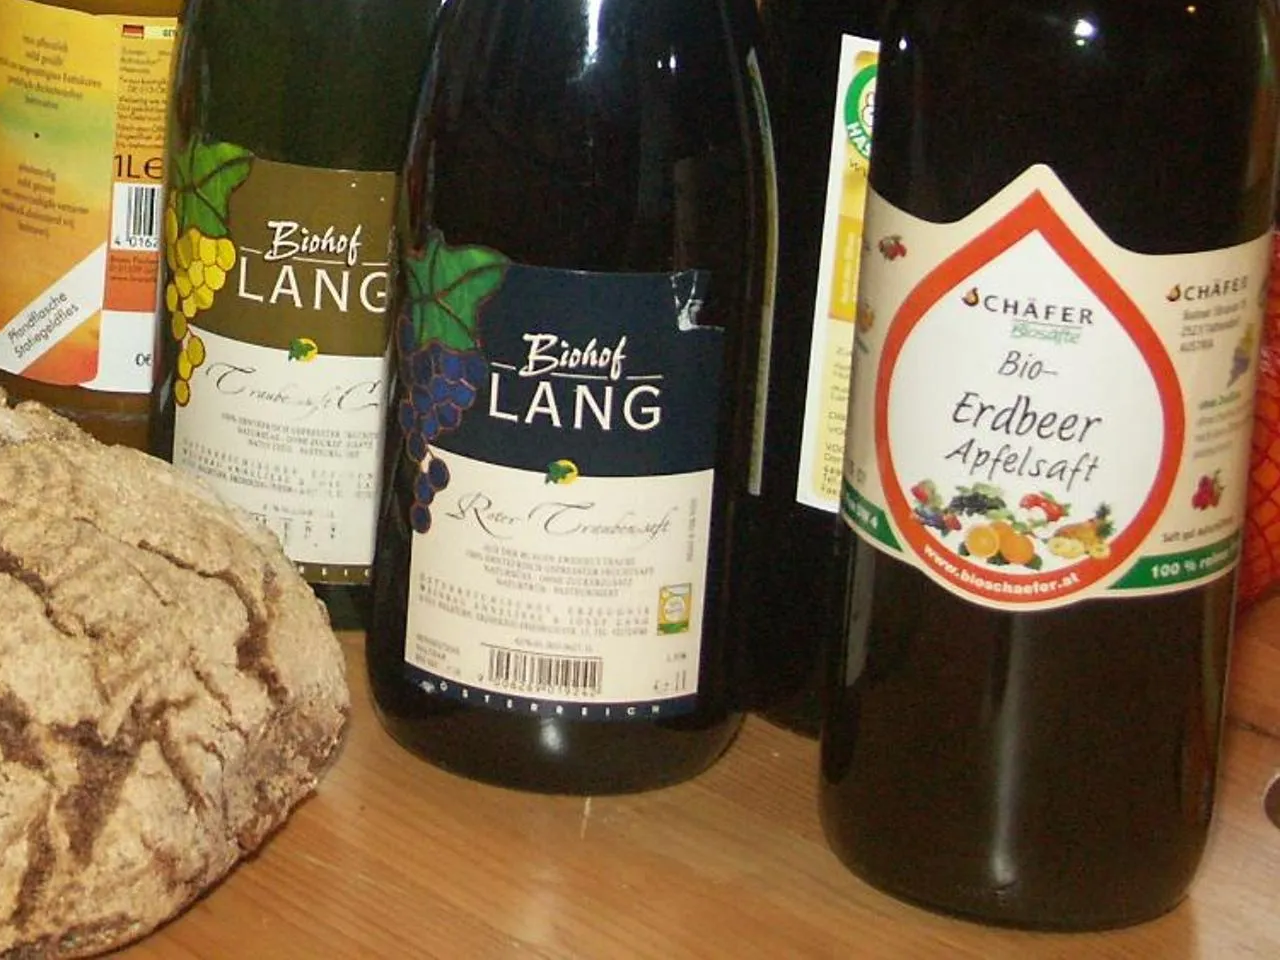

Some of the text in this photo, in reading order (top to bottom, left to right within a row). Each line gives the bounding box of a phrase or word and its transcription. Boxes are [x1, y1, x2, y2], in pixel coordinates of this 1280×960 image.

[264, 220, 362, 267] Biohof
[237, 255, 389, 313] LANG
[518, 333, 627, 382] Biohof
[997, 349, 1059, 381] Bio-
[488, 373, 663, 431] LANG
[951, 391, 1103, 443] Erdbeer
[944, 437, 1100, 493] Apfelsaft
[445, 491, 678, 550] Roter Traubensaft
[923, 543, 1081, 596] www.bioschaefer.at
[1150, 562, 1181, 580] 100
